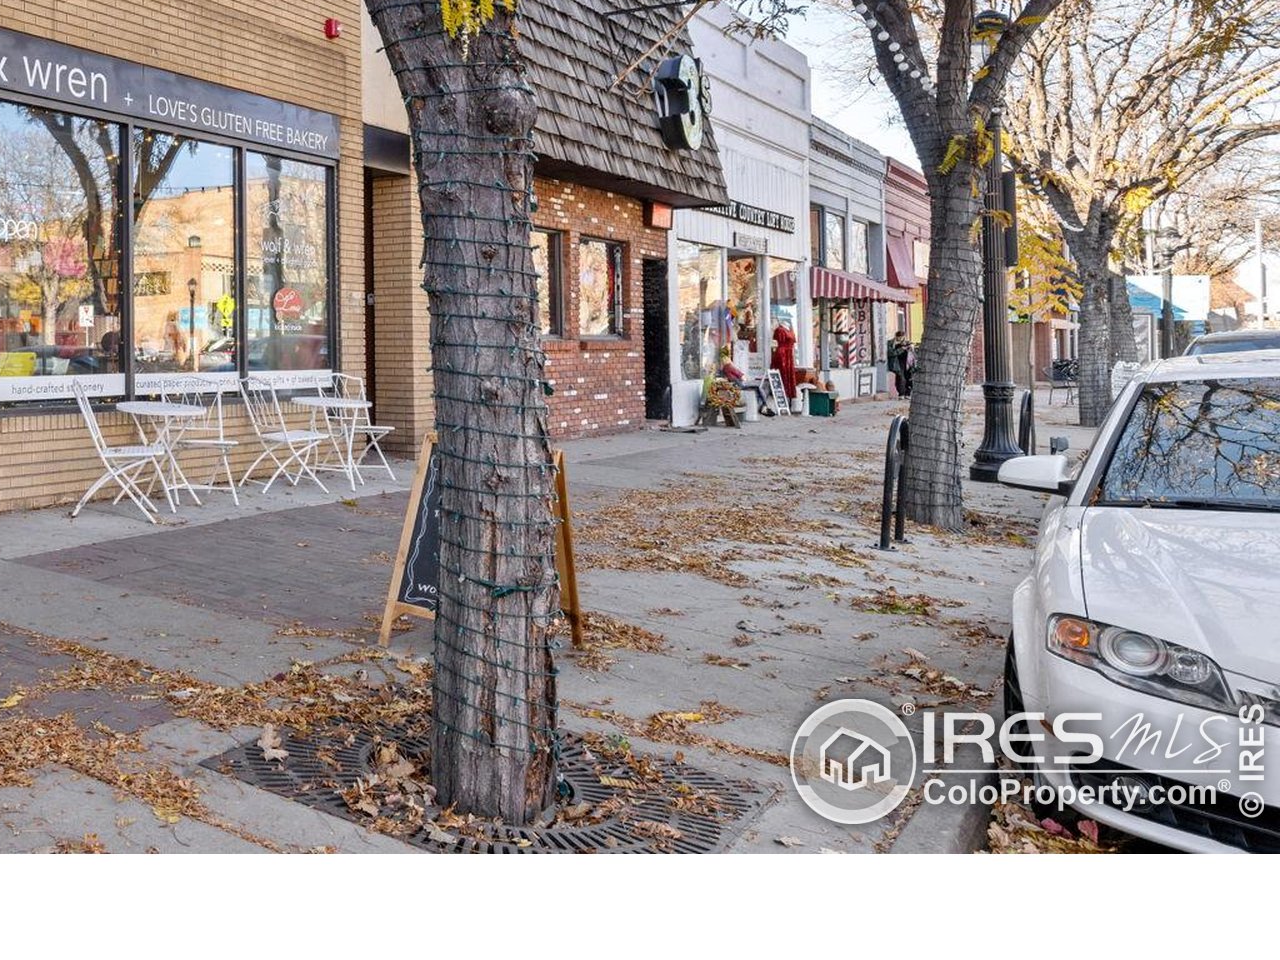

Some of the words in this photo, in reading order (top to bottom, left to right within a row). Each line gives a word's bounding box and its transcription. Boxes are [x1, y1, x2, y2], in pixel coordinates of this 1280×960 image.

[23, 55, 108, 103] wren
[149, 94, 197, 123] LOVE'S
[201, 107, 252, 137] GLUTEN
[255, 119, 283, 142] FREE
[286, 127, 328, 152] BAKERY
[12, 384, 65, 395] hand-crafted
[66, 383, 104, 393] stonery
